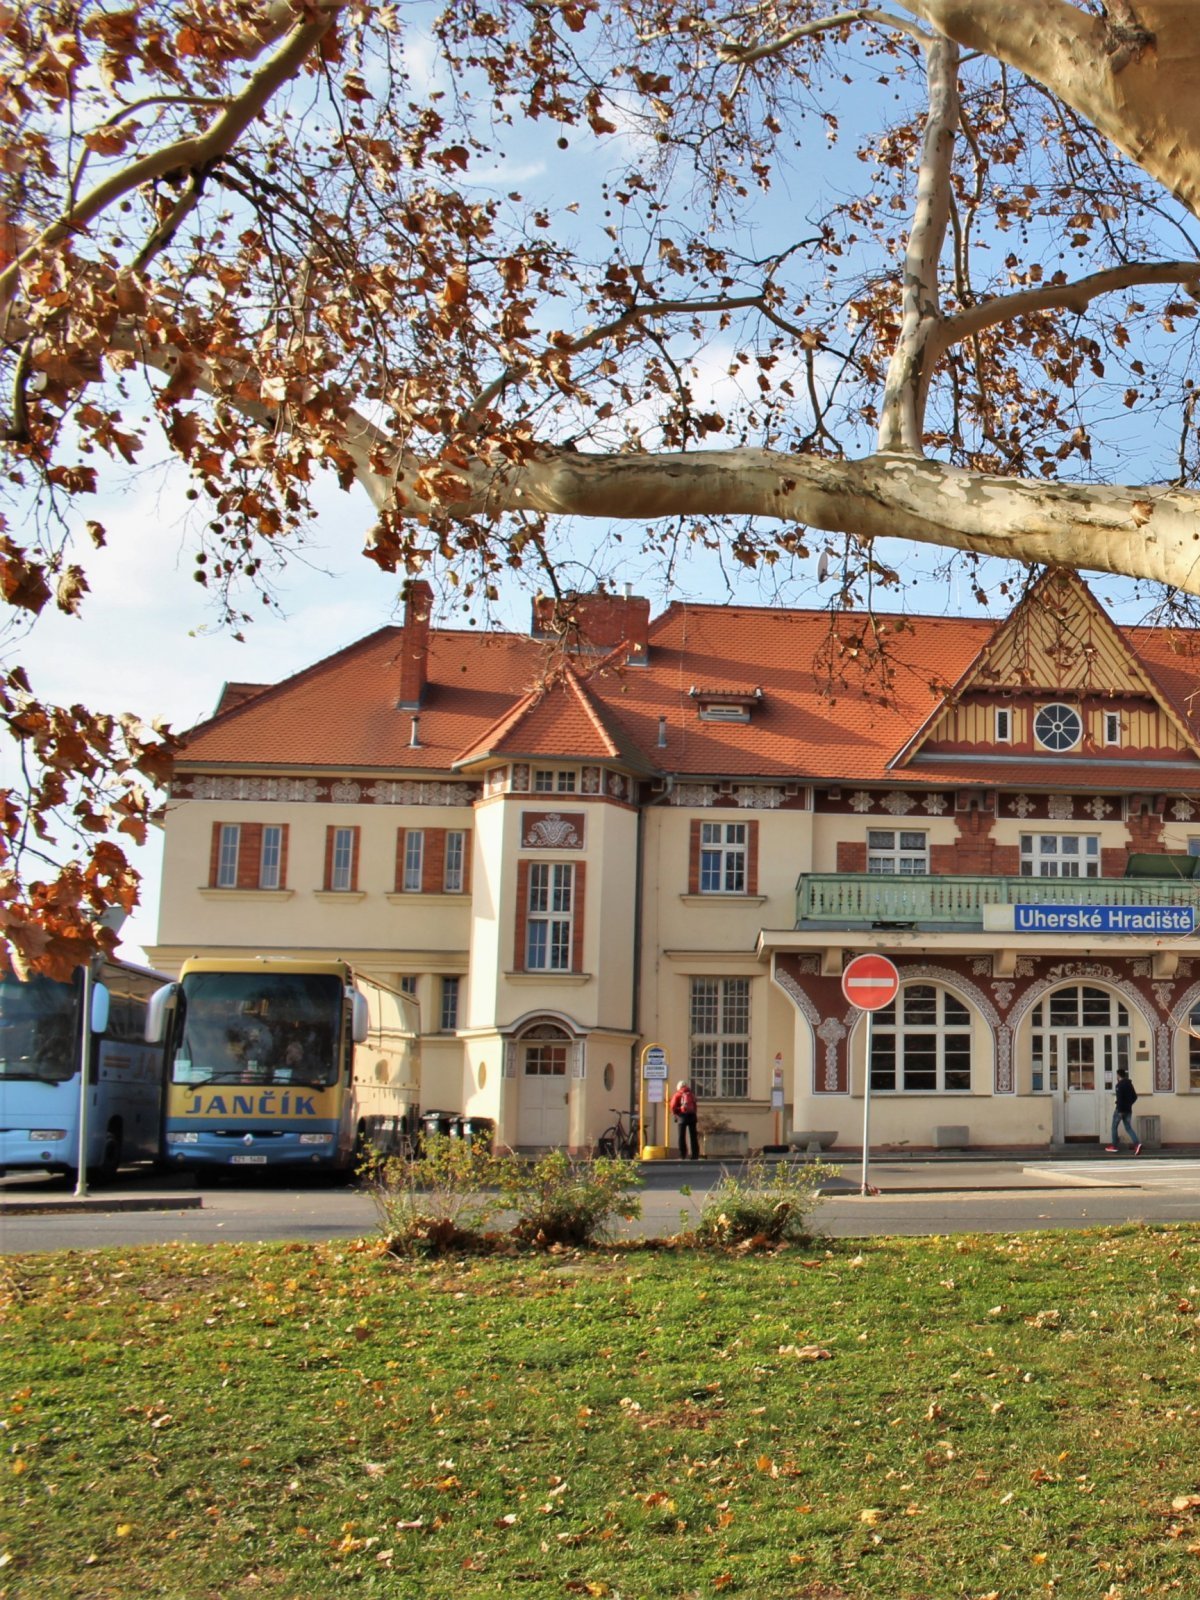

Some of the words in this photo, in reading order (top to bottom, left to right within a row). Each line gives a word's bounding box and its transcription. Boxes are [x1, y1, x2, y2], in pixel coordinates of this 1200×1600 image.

[1019, 909, 1102, 928] Uherské
[1108, 909, 1191, 929] Hradiště
[185, 1090, 317, 1115] JANČÍK
